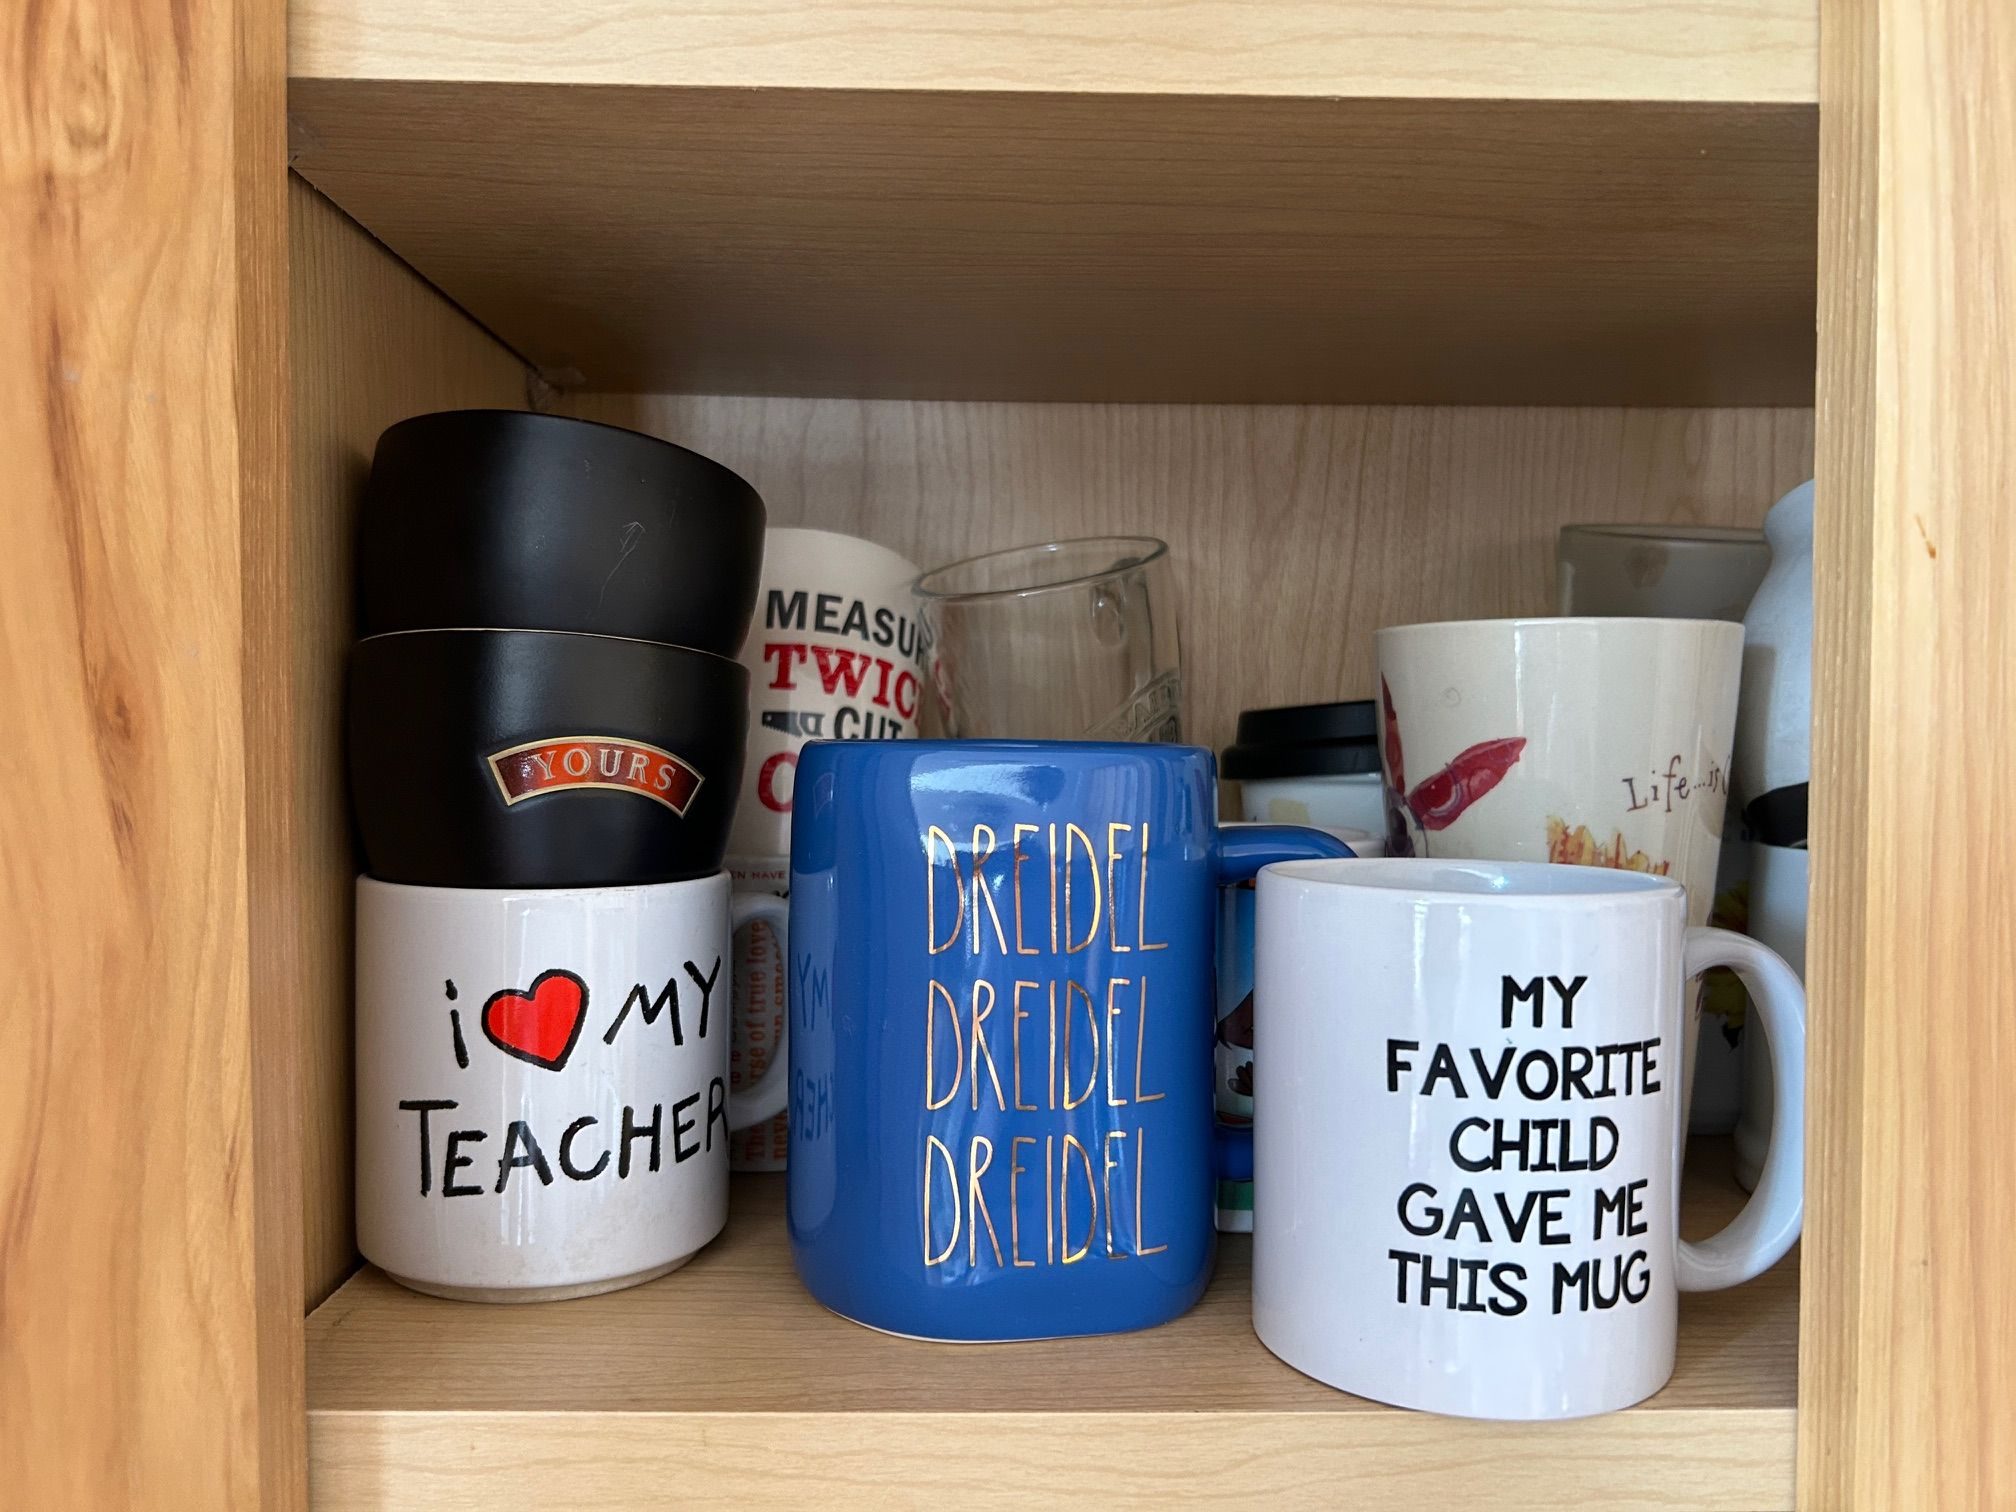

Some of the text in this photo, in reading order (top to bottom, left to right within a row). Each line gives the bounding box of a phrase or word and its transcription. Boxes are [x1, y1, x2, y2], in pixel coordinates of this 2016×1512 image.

[532, 747, 677, 791] YOURS
[926, 822, 1169, 955] DREIDEL
[445, 978, 470, 1070] i
[602, 955, 722, 1046] MY
[1501, 975, 1589, 1029] MY
[925, 975, 1166, 1111] DREIDEL
[1386, 1037, 1662, 1101] FAVORITE
[399, 1076, 729, 1198] TEACHER
[1449, 1115, 1620, 1173] CHILD
[923, 1126, 1168, 1267] DREIDEL
[1396, 1178, 1649, 1246] GAVE ME
[1388, 1248, 1651, 1317] THIS MUG
